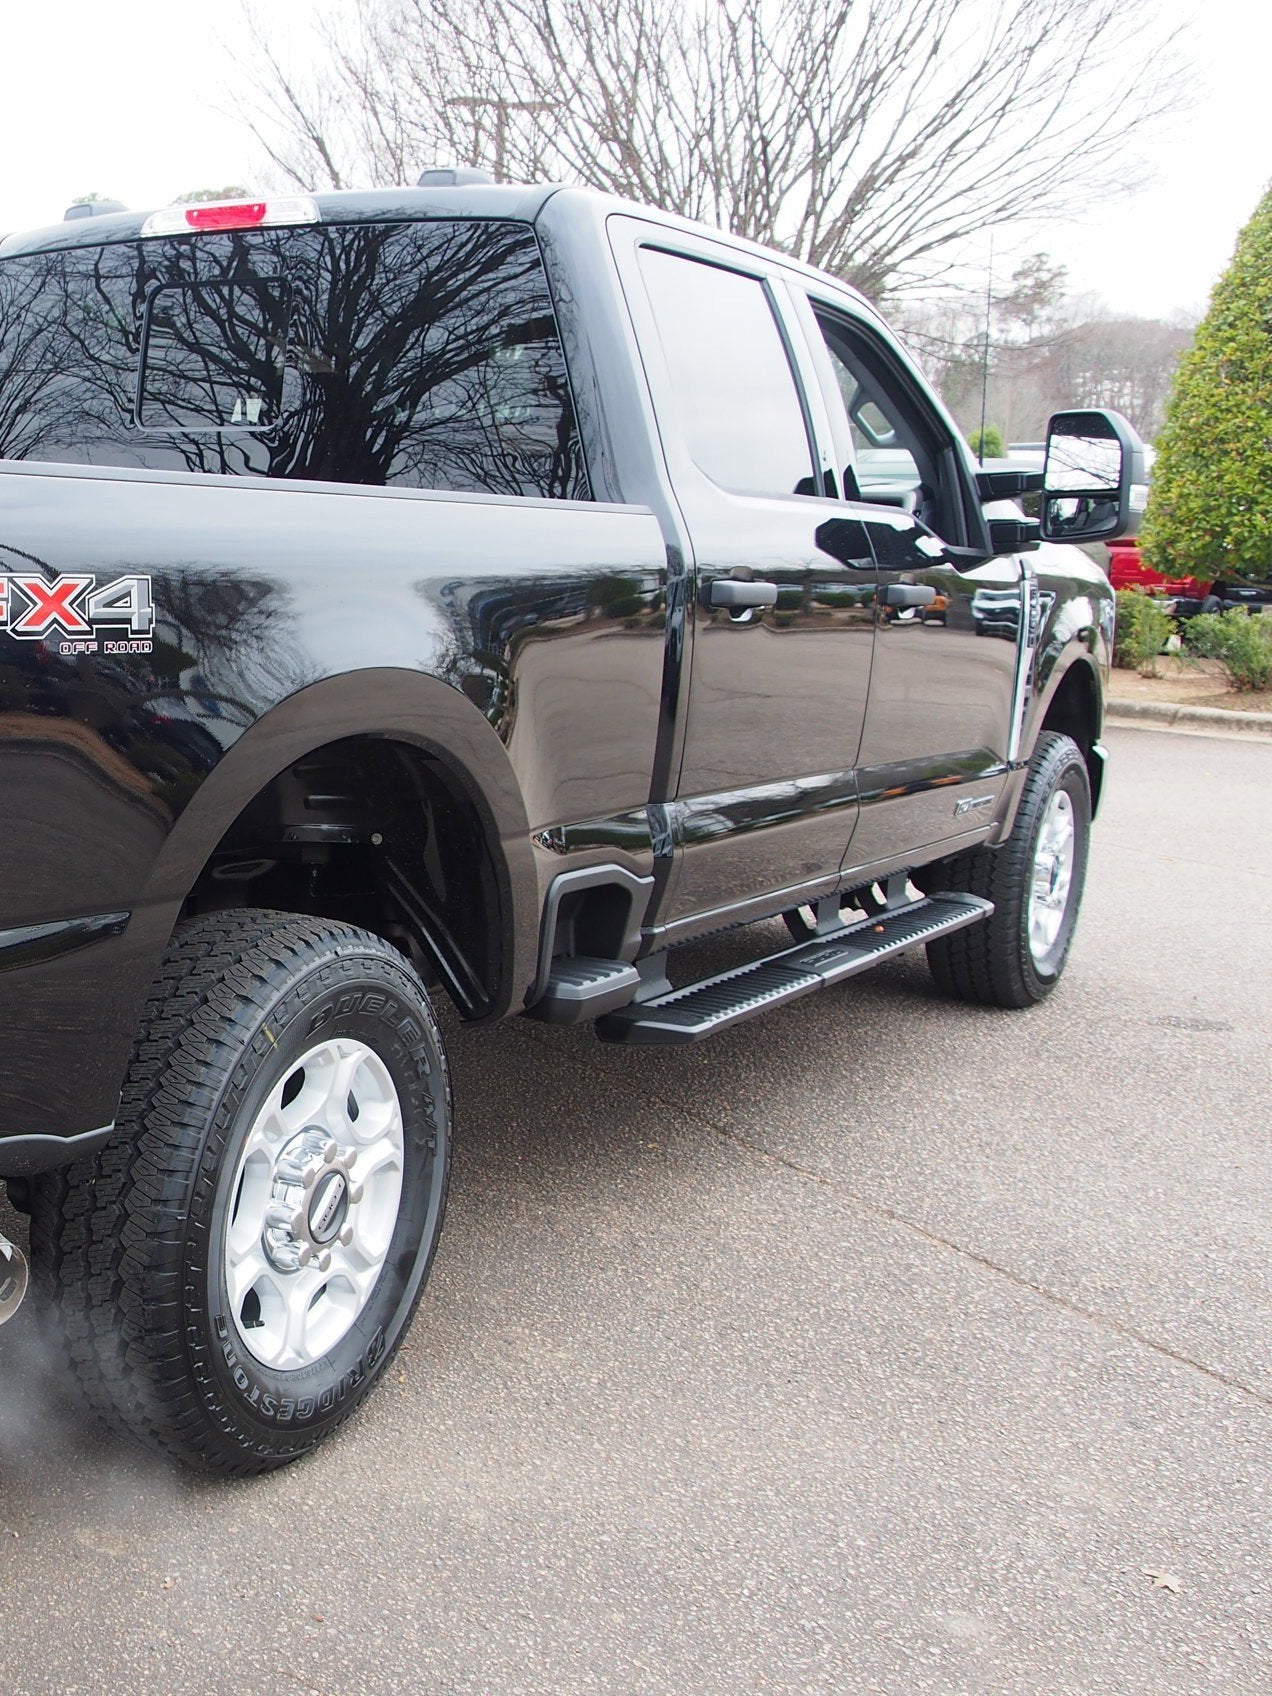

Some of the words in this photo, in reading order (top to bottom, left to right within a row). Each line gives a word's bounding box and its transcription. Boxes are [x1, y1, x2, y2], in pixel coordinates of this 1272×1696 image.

[59, 641, 98, 655] OFF
[104, 640, 153, 654] ROAD
[304, 992, 432, 1080] DUELER
[215, 1311, 387, 1423] BRIDGESTONE
